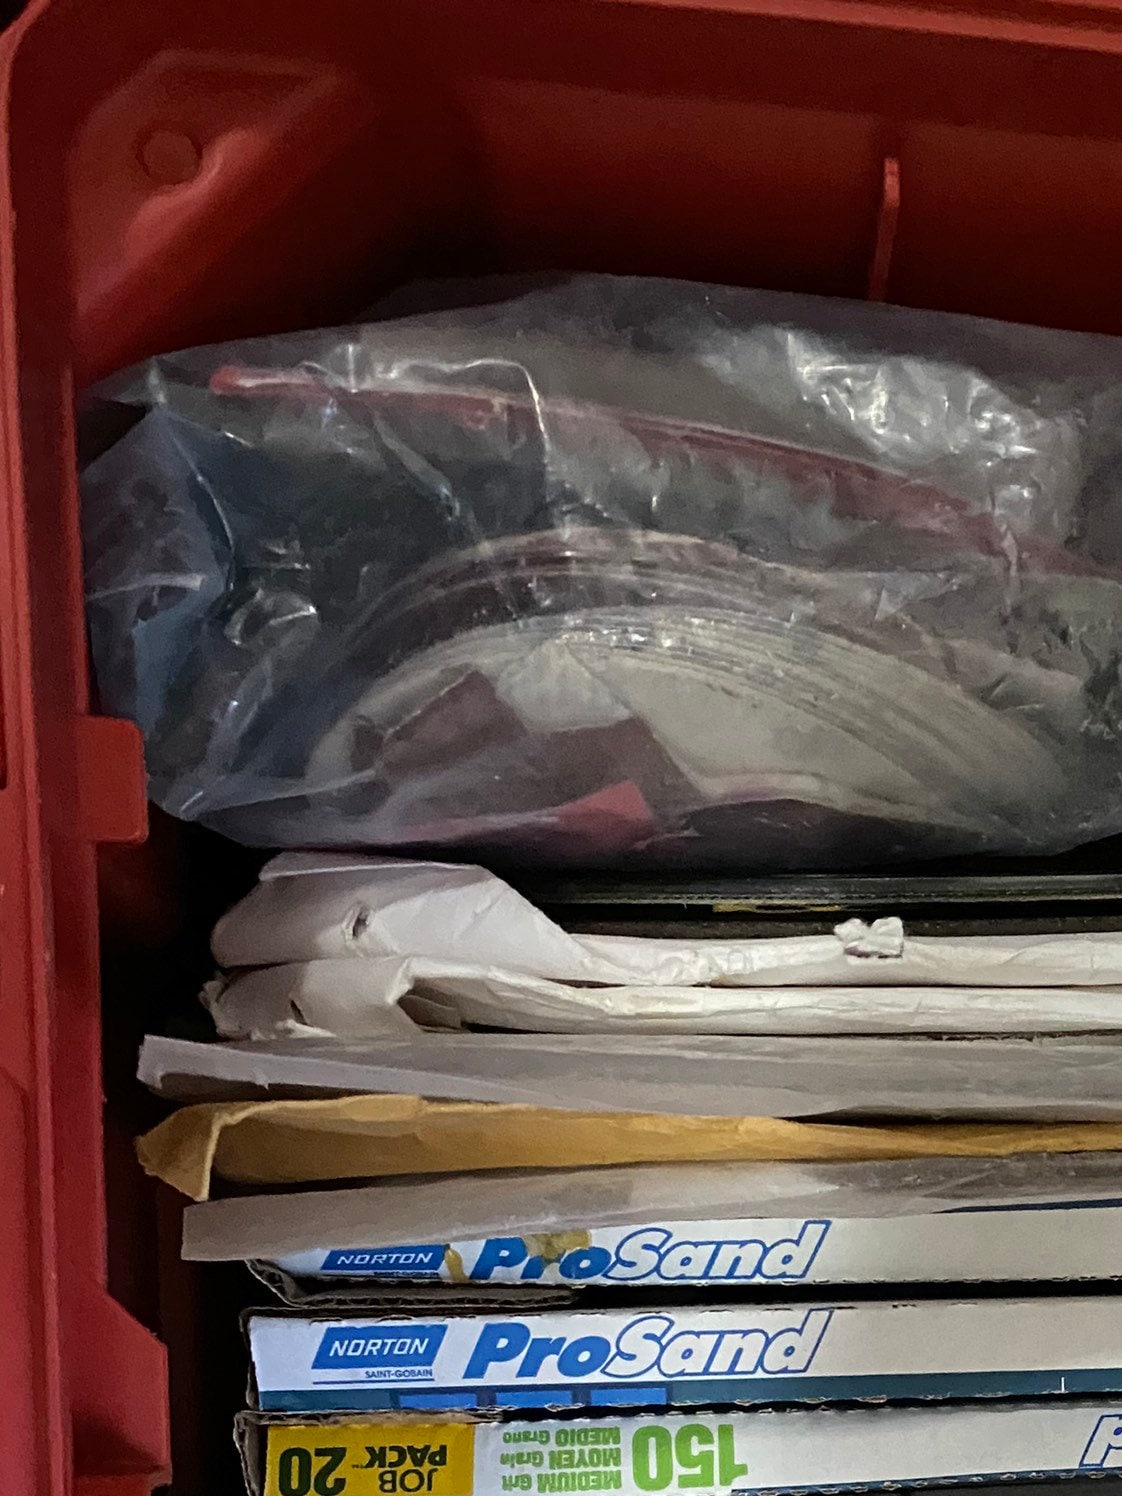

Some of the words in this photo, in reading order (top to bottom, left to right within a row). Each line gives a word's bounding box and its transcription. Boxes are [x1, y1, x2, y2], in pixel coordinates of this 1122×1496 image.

[337, 1252, 433, 1265] NORTON
[329, 1338, 429, 1357] NORTON
[462, 1308, 834, 1379] ProSand
[365, 1368, 433, 1379] SAINT-GOBAIN
[503, 1429, 550, 1444] Grano
[555, 1427, 621, 1447] MEDIO
[500, 1450, 543, 1468] Grain
[549, 1448, 621, 1469] MOYEN
[632, 1423, 748, 1491] 150
[378, 1468, 439, 1494] JOB
[502, 1474, 532, 1491] Grit
[537, 1470, 622, 1493] MEDIUM
